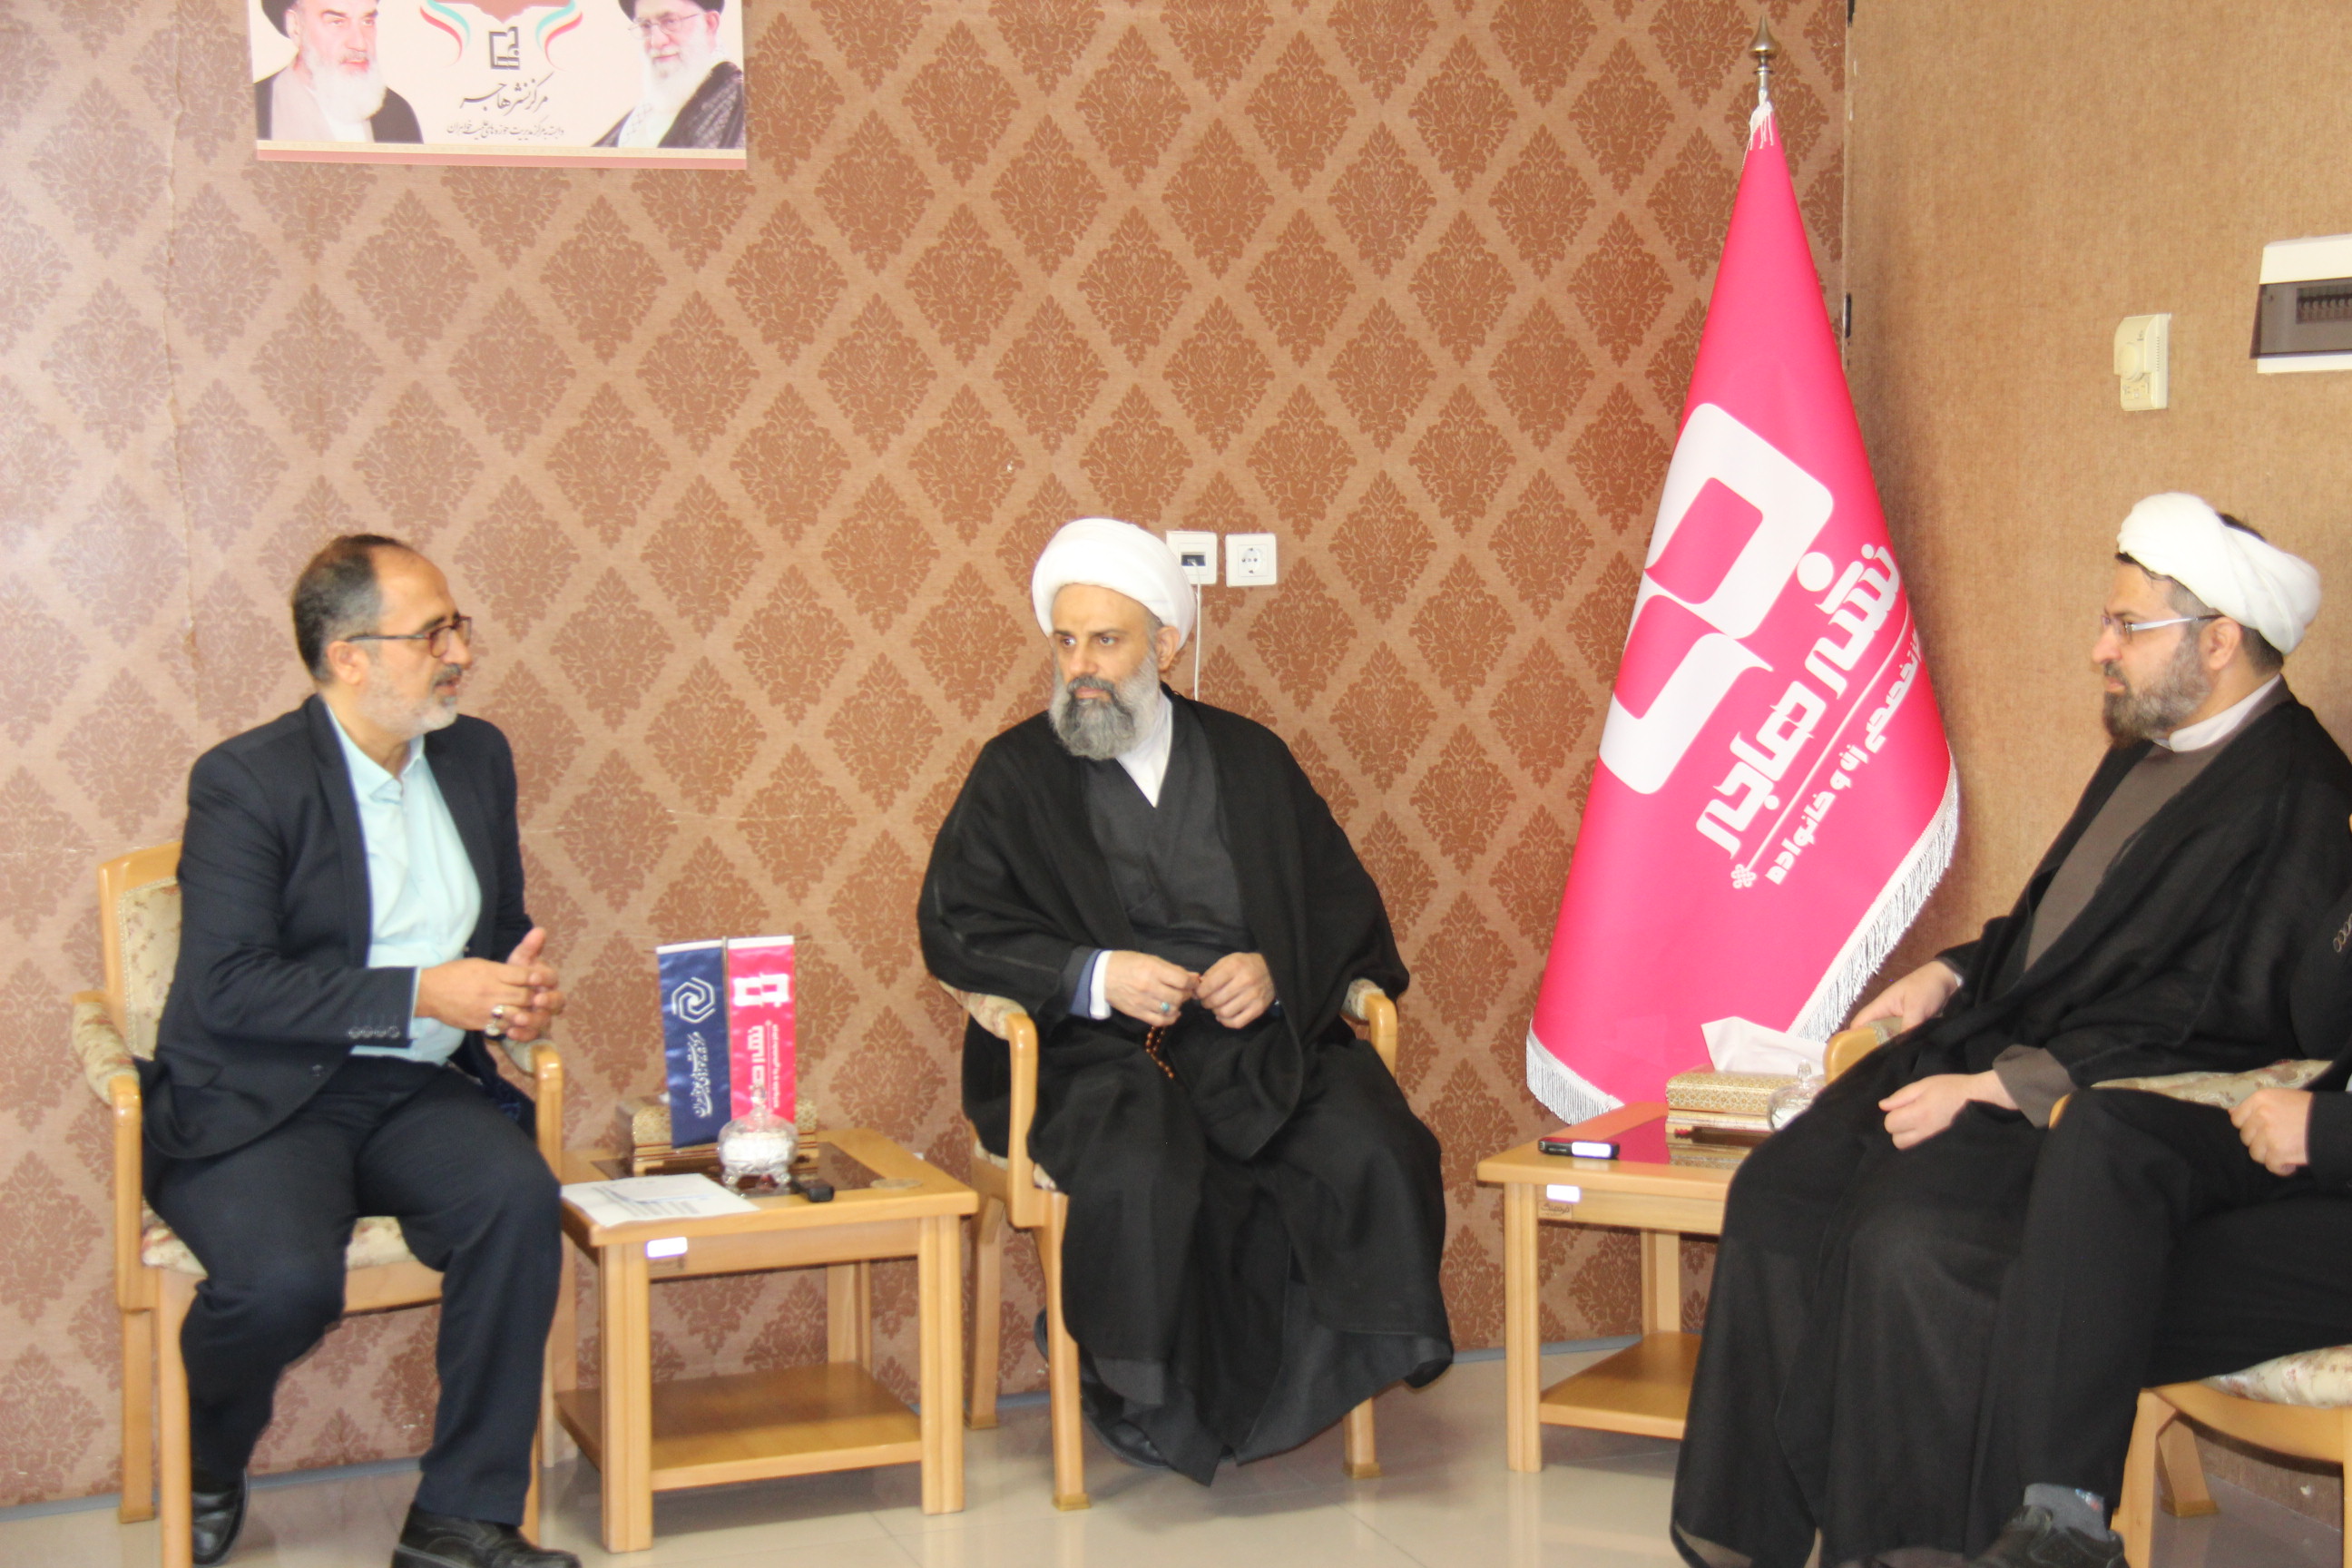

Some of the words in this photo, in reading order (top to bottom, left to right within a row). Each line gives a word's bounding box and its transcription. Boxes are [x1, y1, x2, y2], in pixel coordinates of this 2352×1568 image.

[458, 83, 512, 112] هاجر
[504, 82, 531, 116] نشر
[524, 71, 555, 113] مرکز
[1804, 544, 1899, 701] نشر
[1865, 650, 1918, 754] تخصصی
[1695, 680, 1828, 860] هاجر
[1838, 743, 1869, 771] زن
[1829, 769, 1852, 790] و
[1764, 790, 1837, 886] خانواده
